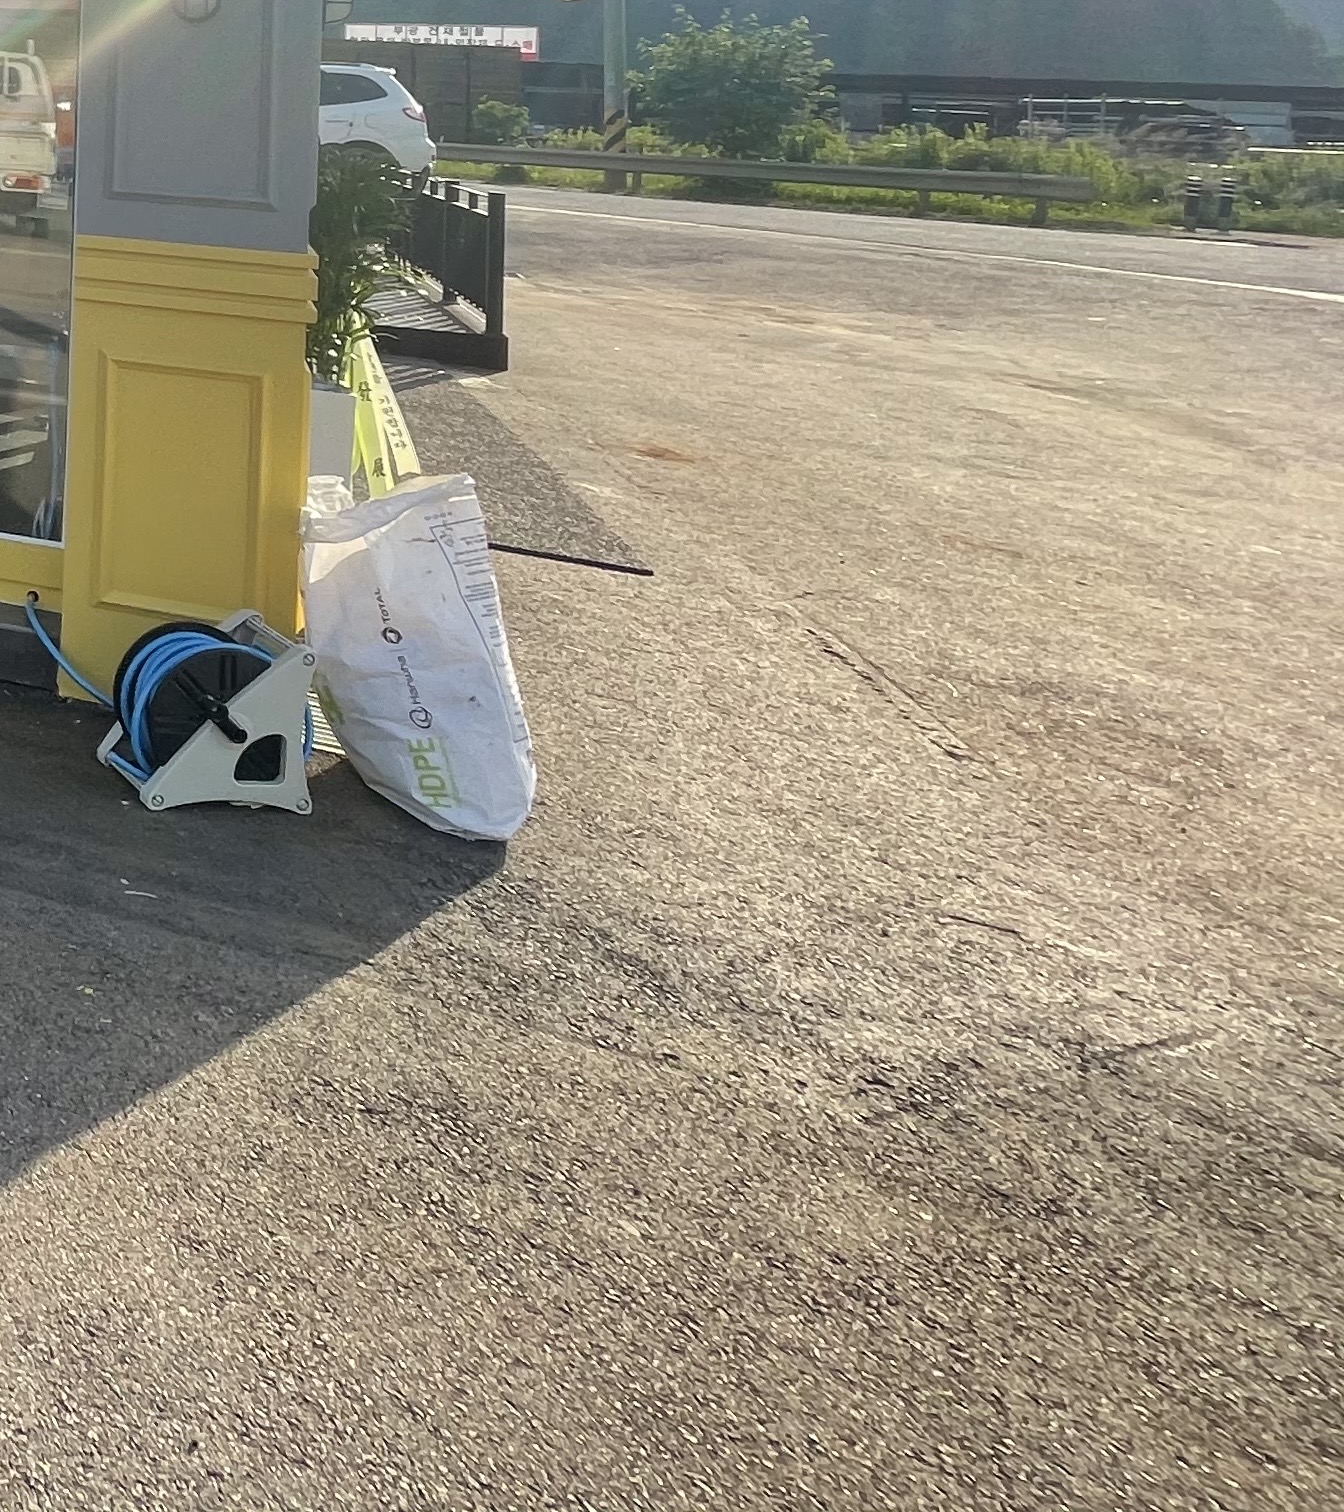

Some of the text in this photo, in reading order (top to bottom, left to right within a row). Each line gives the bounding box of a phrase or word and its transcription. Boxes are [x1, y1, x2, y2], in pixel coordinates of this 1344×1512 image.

[374, 587, 391, 624] TOTAL
[397, 655, 421, 705] Hanwha
[408, 737, 453, 809] HDPE
